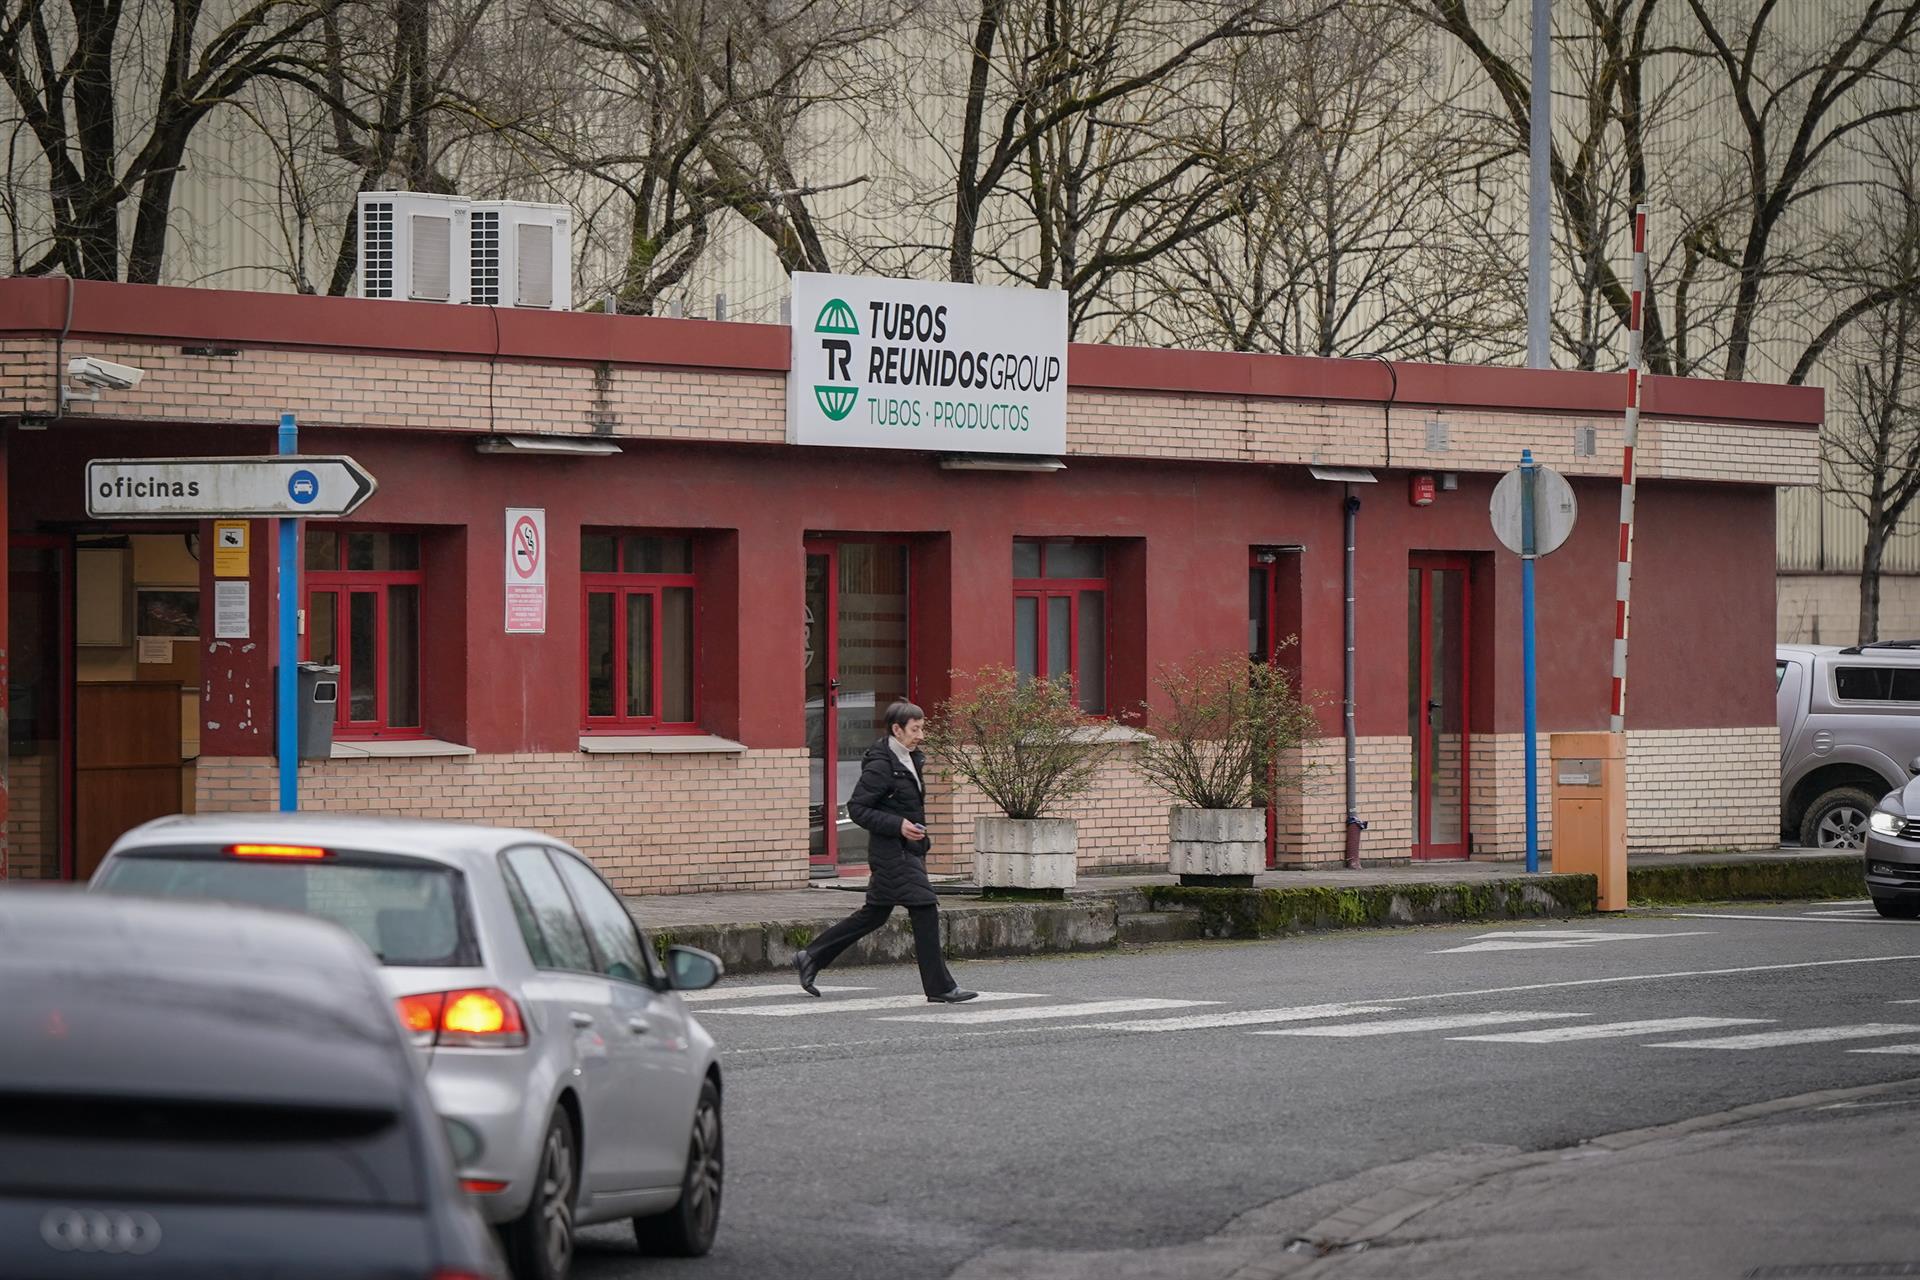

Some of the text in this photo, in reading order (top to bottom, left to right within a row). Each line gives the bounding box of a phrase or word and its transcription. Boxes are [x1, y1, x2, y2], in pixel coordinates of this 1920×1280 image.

[869, 301, 948, 344] TUBOS
[867, 397, 1030, 432] TUBOS PRODUCTOS
[99, 476, 200, 498] oficinas
